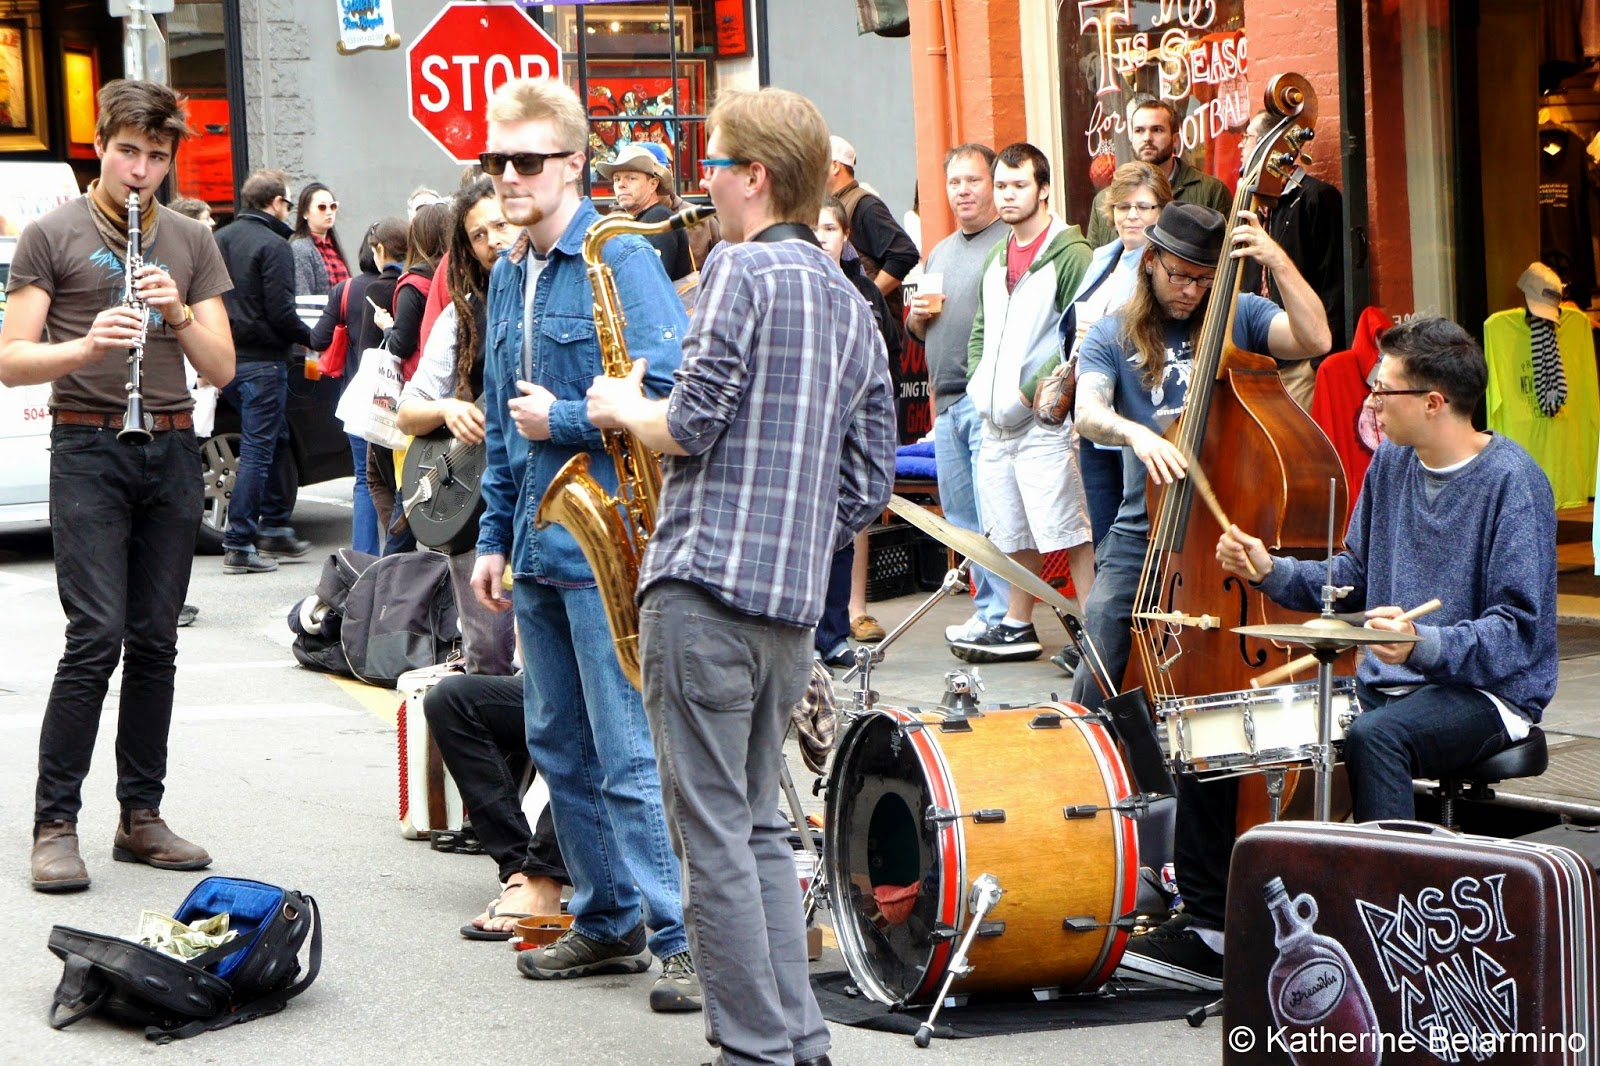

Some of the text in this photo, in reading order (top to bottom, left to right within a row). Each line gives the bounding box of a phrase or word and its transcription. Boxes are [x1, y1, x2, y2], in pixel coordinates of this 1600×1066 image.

[1159, 28, 1247, 100] SEASO
[1085, 101, 1126, 157] for
[1355, 873, 1516, 993] ROSSI
[1401, 946, 1518, 1063] GANG
